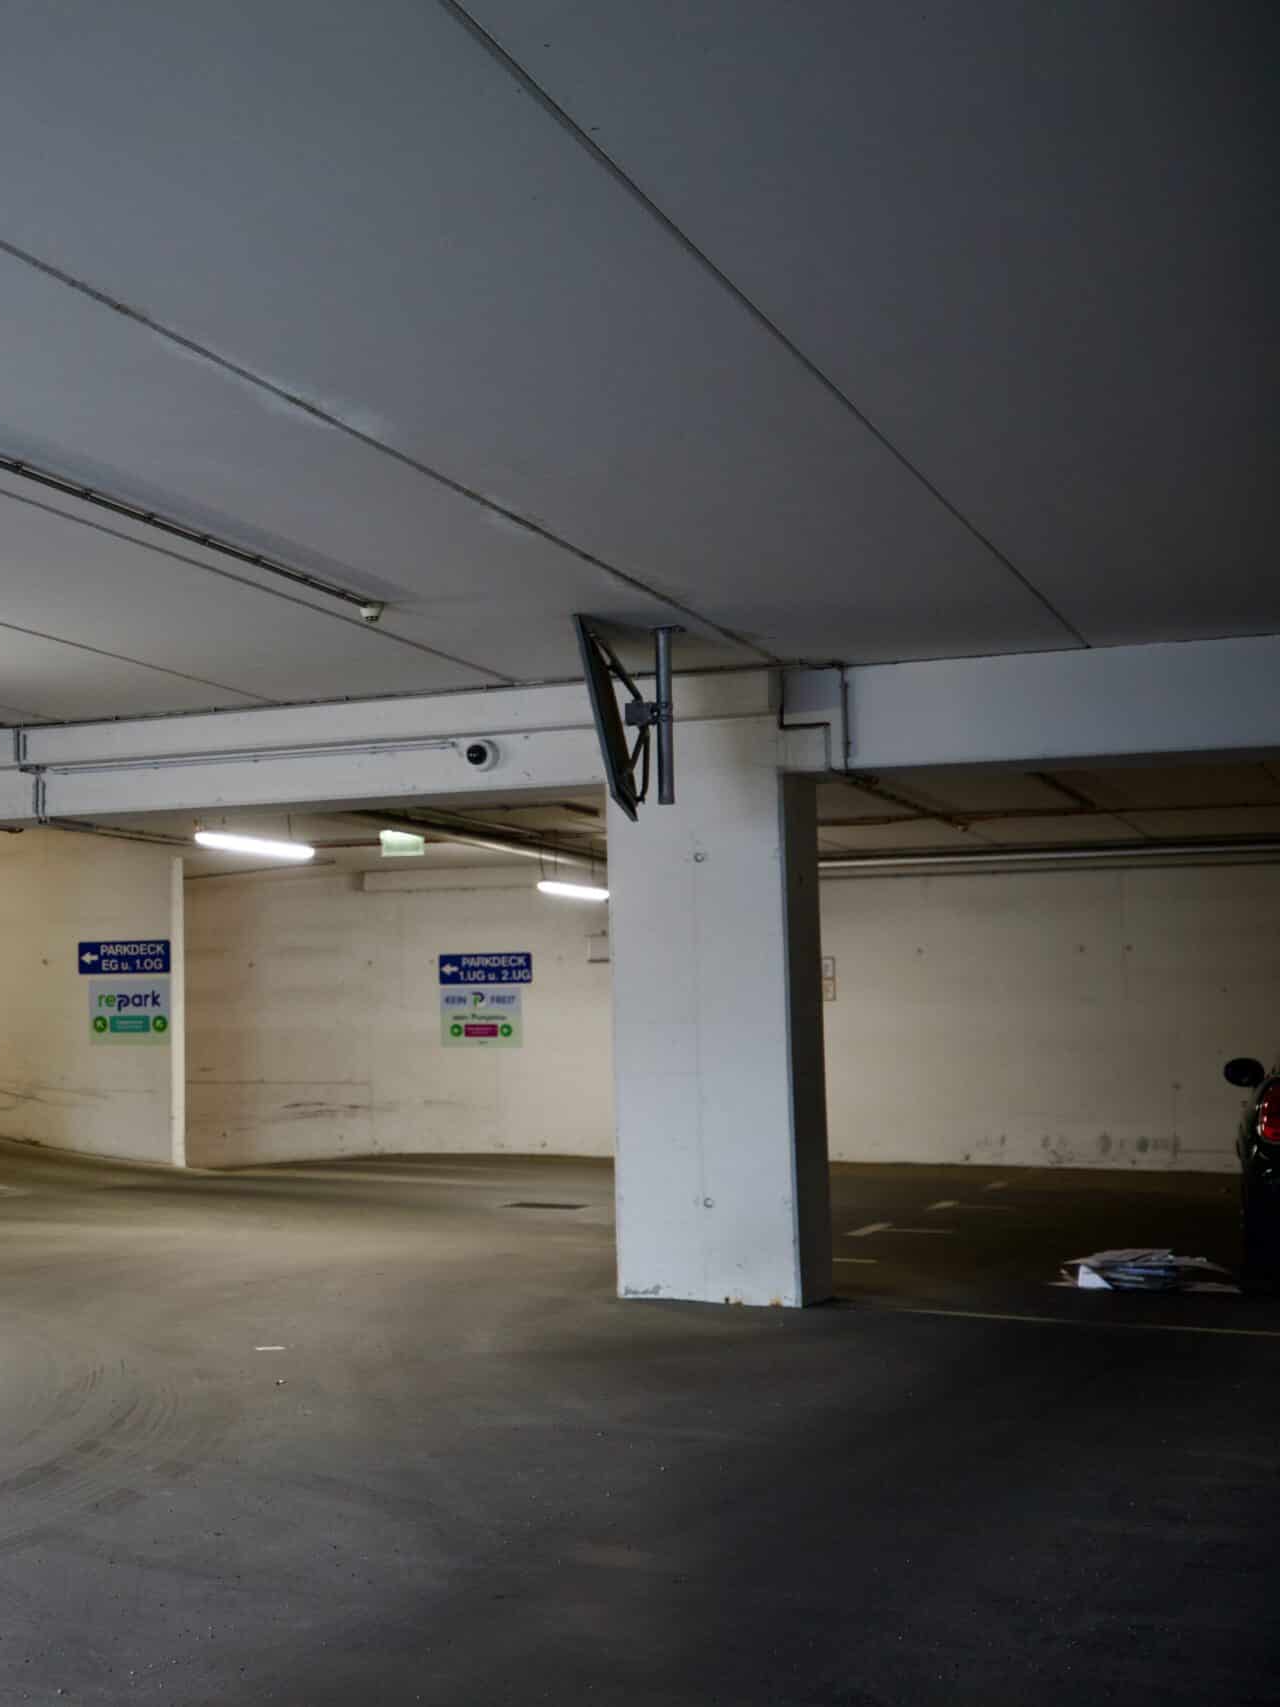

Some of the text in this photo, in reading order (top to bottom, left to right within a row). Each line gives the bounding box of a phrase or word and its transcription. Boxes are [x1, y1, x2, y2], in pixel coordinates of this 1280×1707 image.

[100, 943, 165, 957] PARKDECK
[101, 959, 119, 971] EG
[135, 958, 163, 970] 1.OG
[462, 955, 527, 968] PARKDECK
[459, 970, 486, 981] 1.UG
[501, 969, 531, 981] 2.UG
[97, 989, 161, 1012] repark
